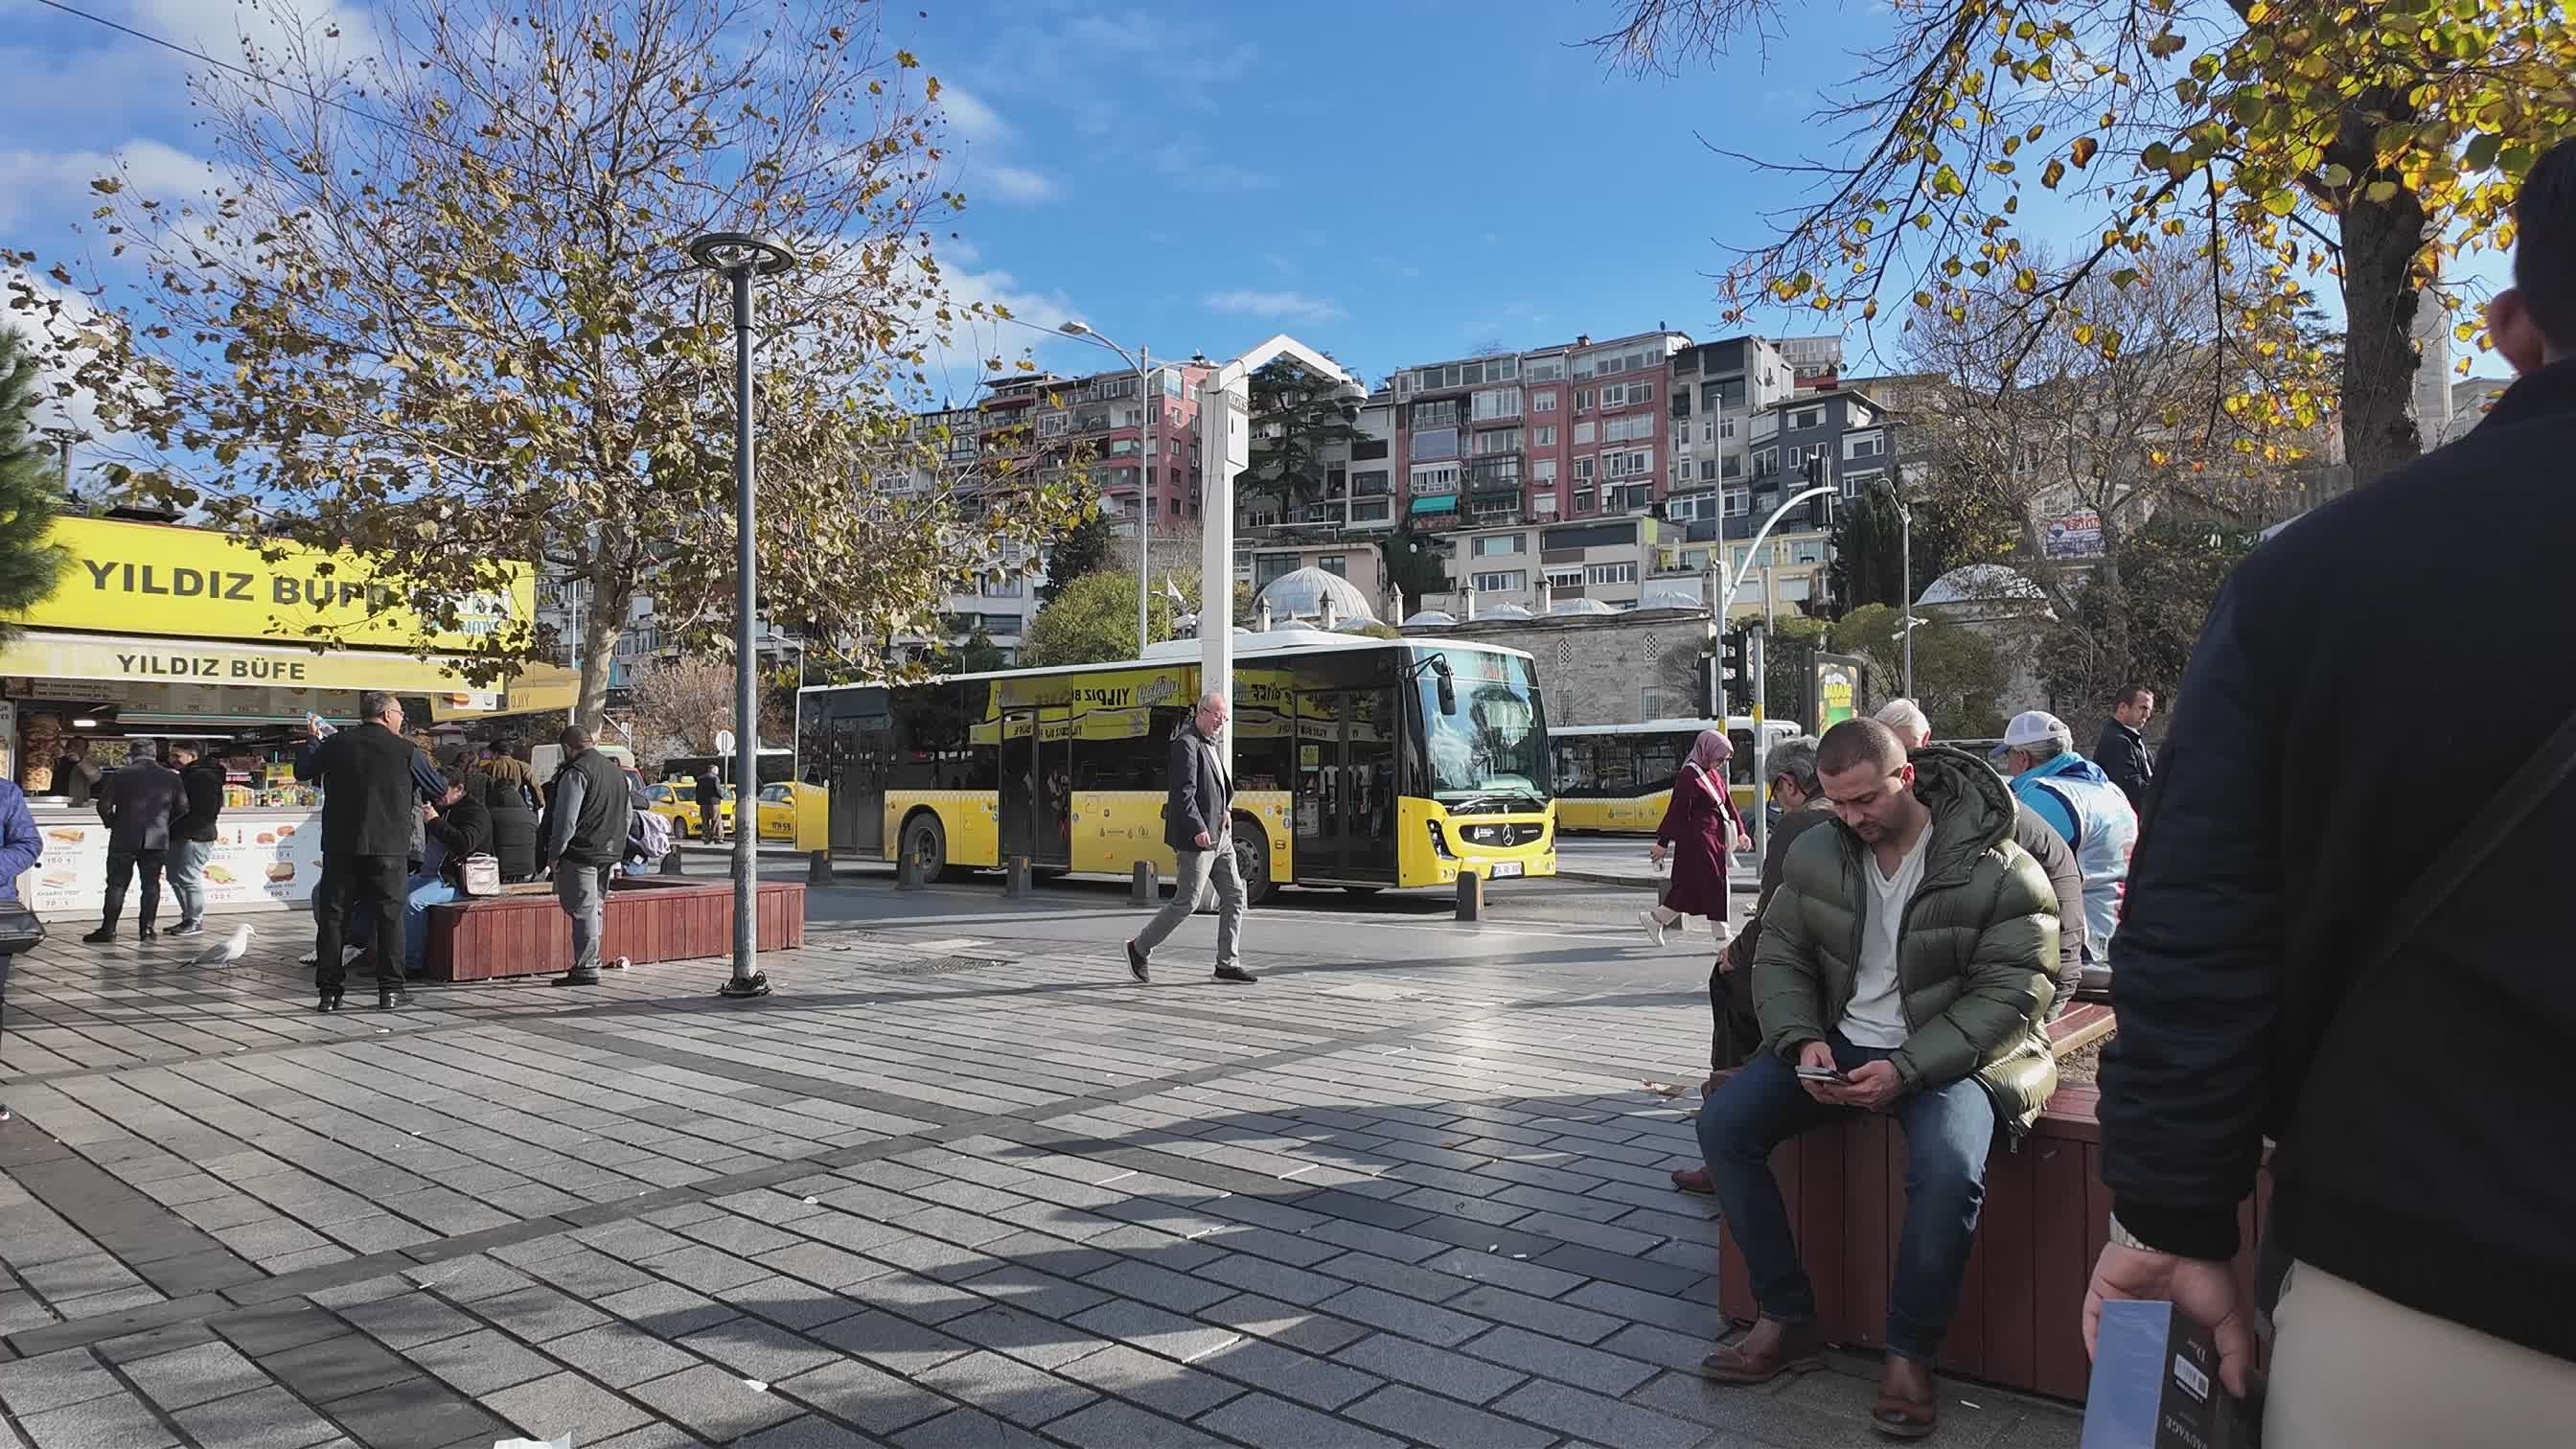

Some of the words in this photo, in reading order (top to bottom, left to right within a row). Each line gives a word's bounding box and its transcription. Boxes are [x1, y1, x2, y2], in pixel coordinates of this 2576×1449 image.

[82, 559, 255, 602] YILDIZ
[272, 572, 389, 611] BÜF
[117, 654, 219, 678] YILDIZ
[231, 657, 306, 680] BÜFE
